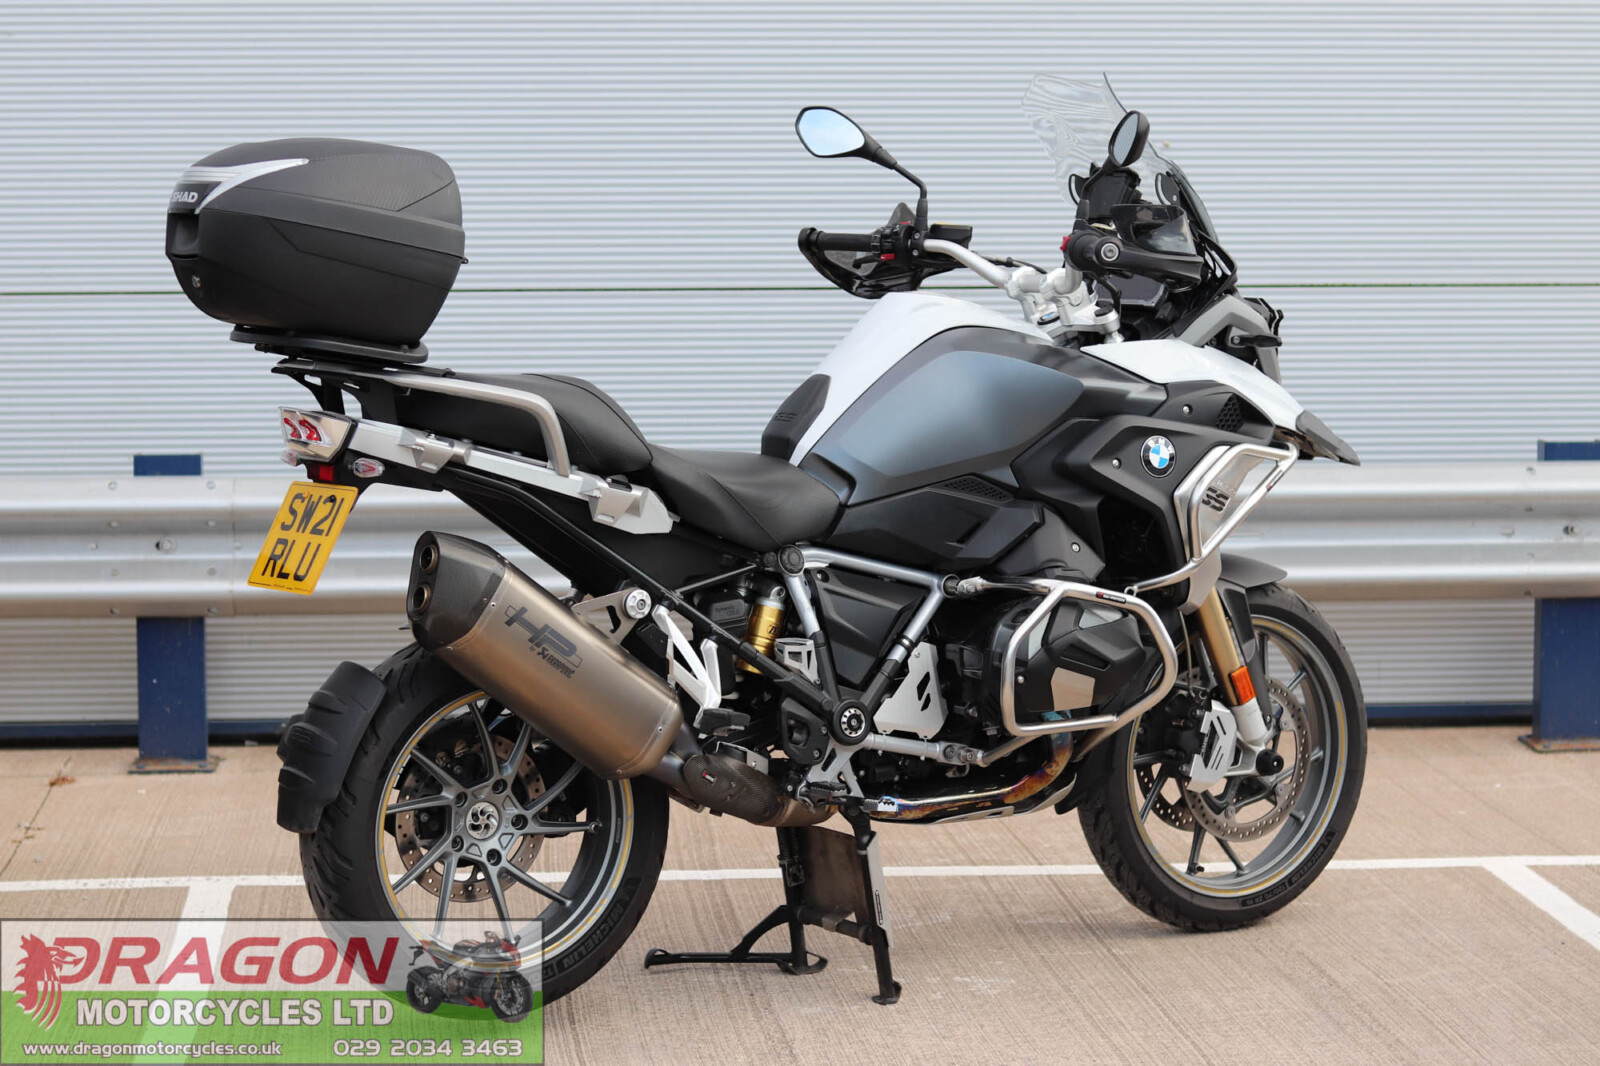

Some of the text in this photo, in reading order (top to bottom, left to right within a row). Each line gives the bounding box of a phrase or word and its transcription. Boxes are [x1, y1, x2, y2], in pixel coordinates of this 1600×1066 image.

[1147, 437, 1175, 454] BMW
[280, 492, 345, 537] SW21
[261, 537, 322, 582] RLU
[562, 903, 624, 968] MICHELIN
